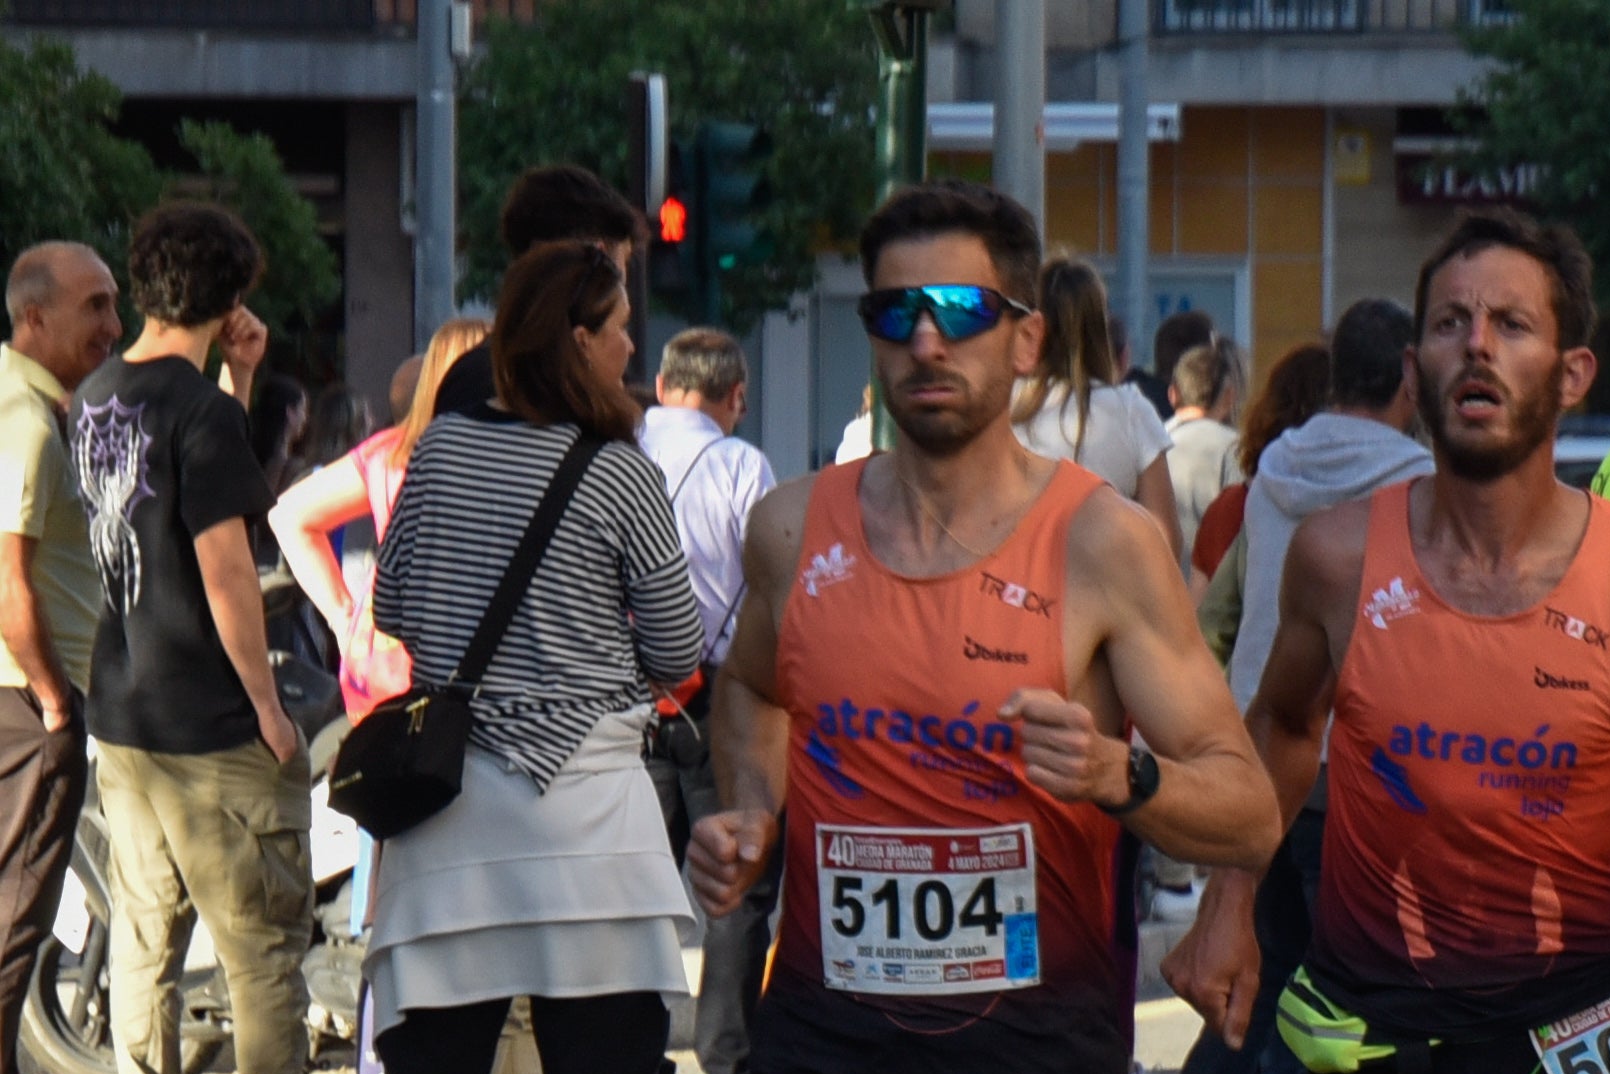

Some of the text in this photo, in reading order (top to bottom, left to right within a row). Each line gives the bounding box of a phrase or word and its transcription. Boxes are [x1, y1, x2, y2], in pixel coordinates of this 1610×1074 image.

[978, 570, 1056, 618] TRACK
[1544, 606, 1610, 650] TRACK
[818, 697, 1013, 751] atracón
[1389, 722, 1577, 769] atracón
[1478, 771, 1571, 791] running
[827, 834, 854, 866] 40
[831, 876, 1003, 941] 5104
